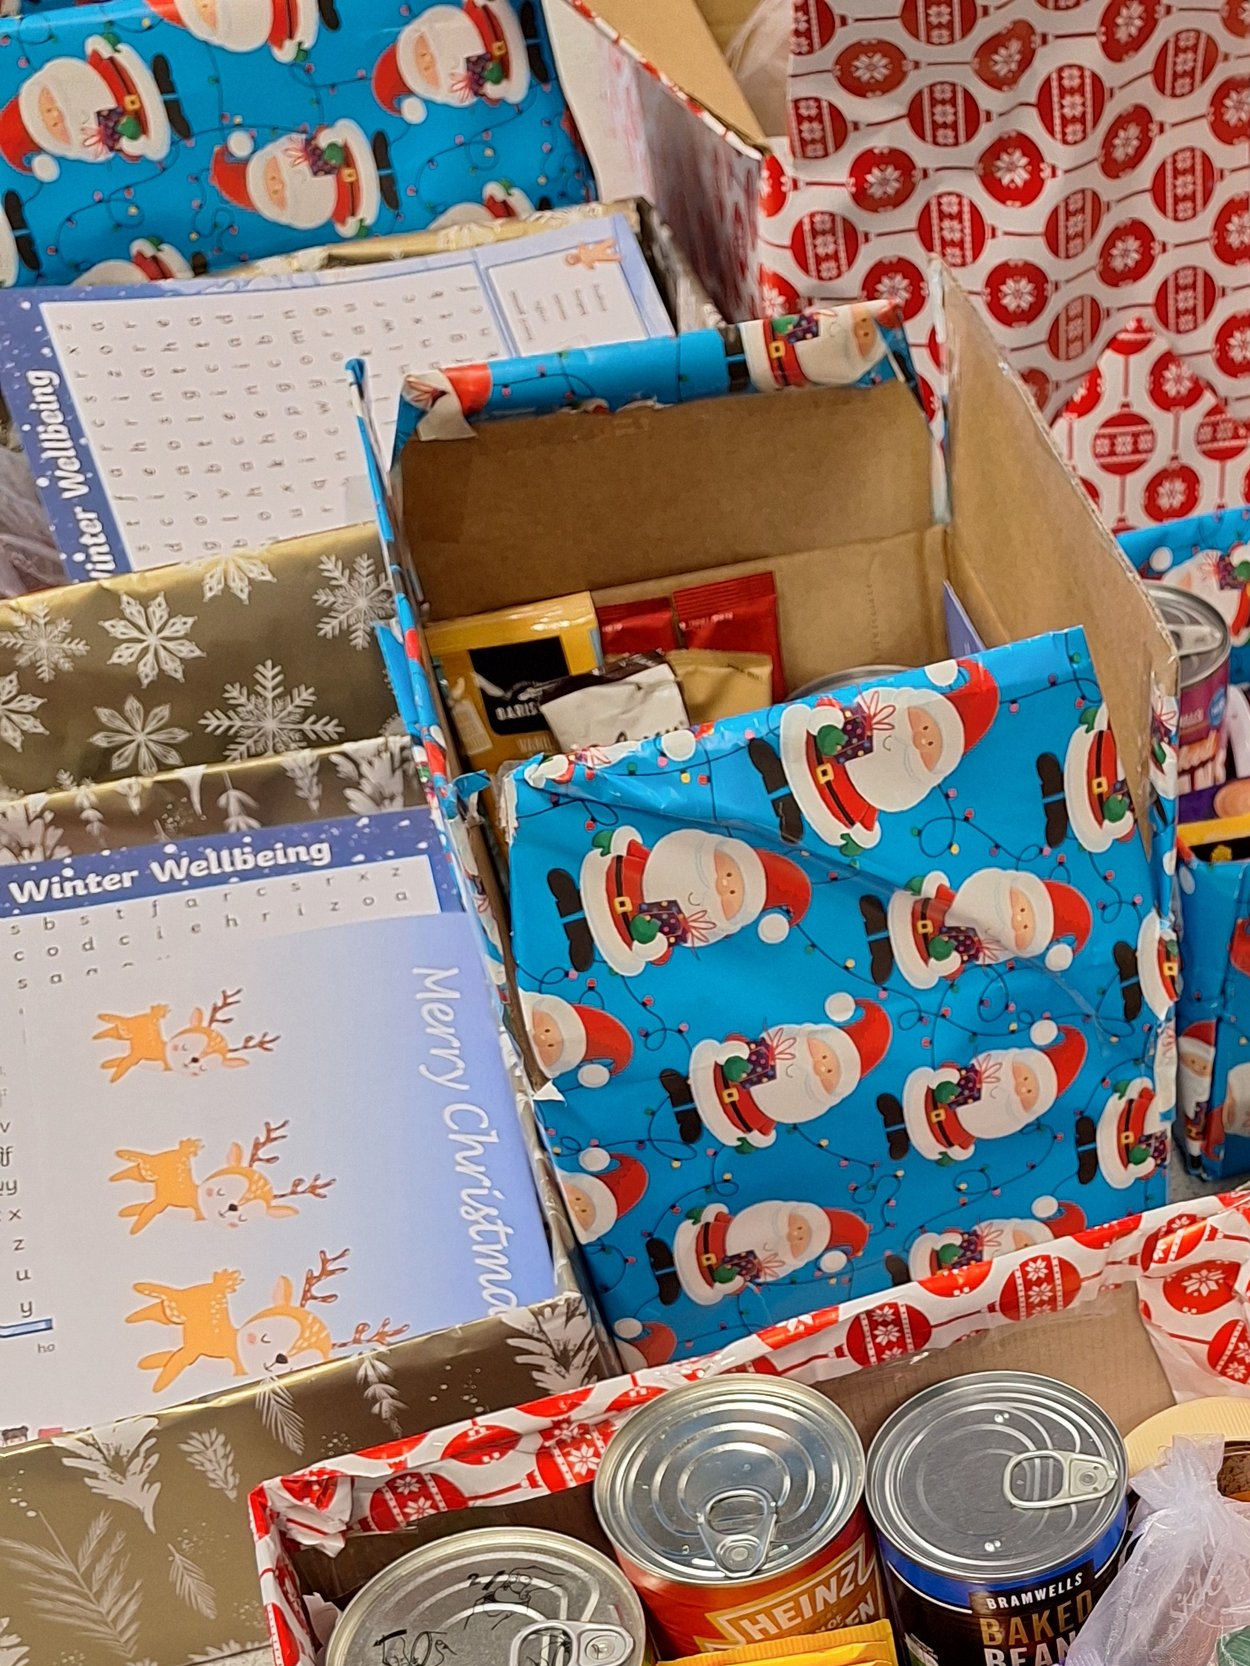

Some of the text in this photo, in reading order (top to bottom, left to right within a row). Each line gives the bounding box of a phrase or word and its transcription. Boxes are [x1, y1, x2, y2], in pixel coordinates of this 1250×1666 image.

[27, 370, 116, 578] inter Wellbeing
[8, 840, 332, 905] Winter Wellbeing
[411, 966, 470, 1093] Merry
[440, 1101, 518, 1317] Christma
[738, 1560, 856, 1641] HEINZ
[979, 1588, 1095, 1646] BAKED
[986, 1571, 1084, 1611] BRAMWELLS
